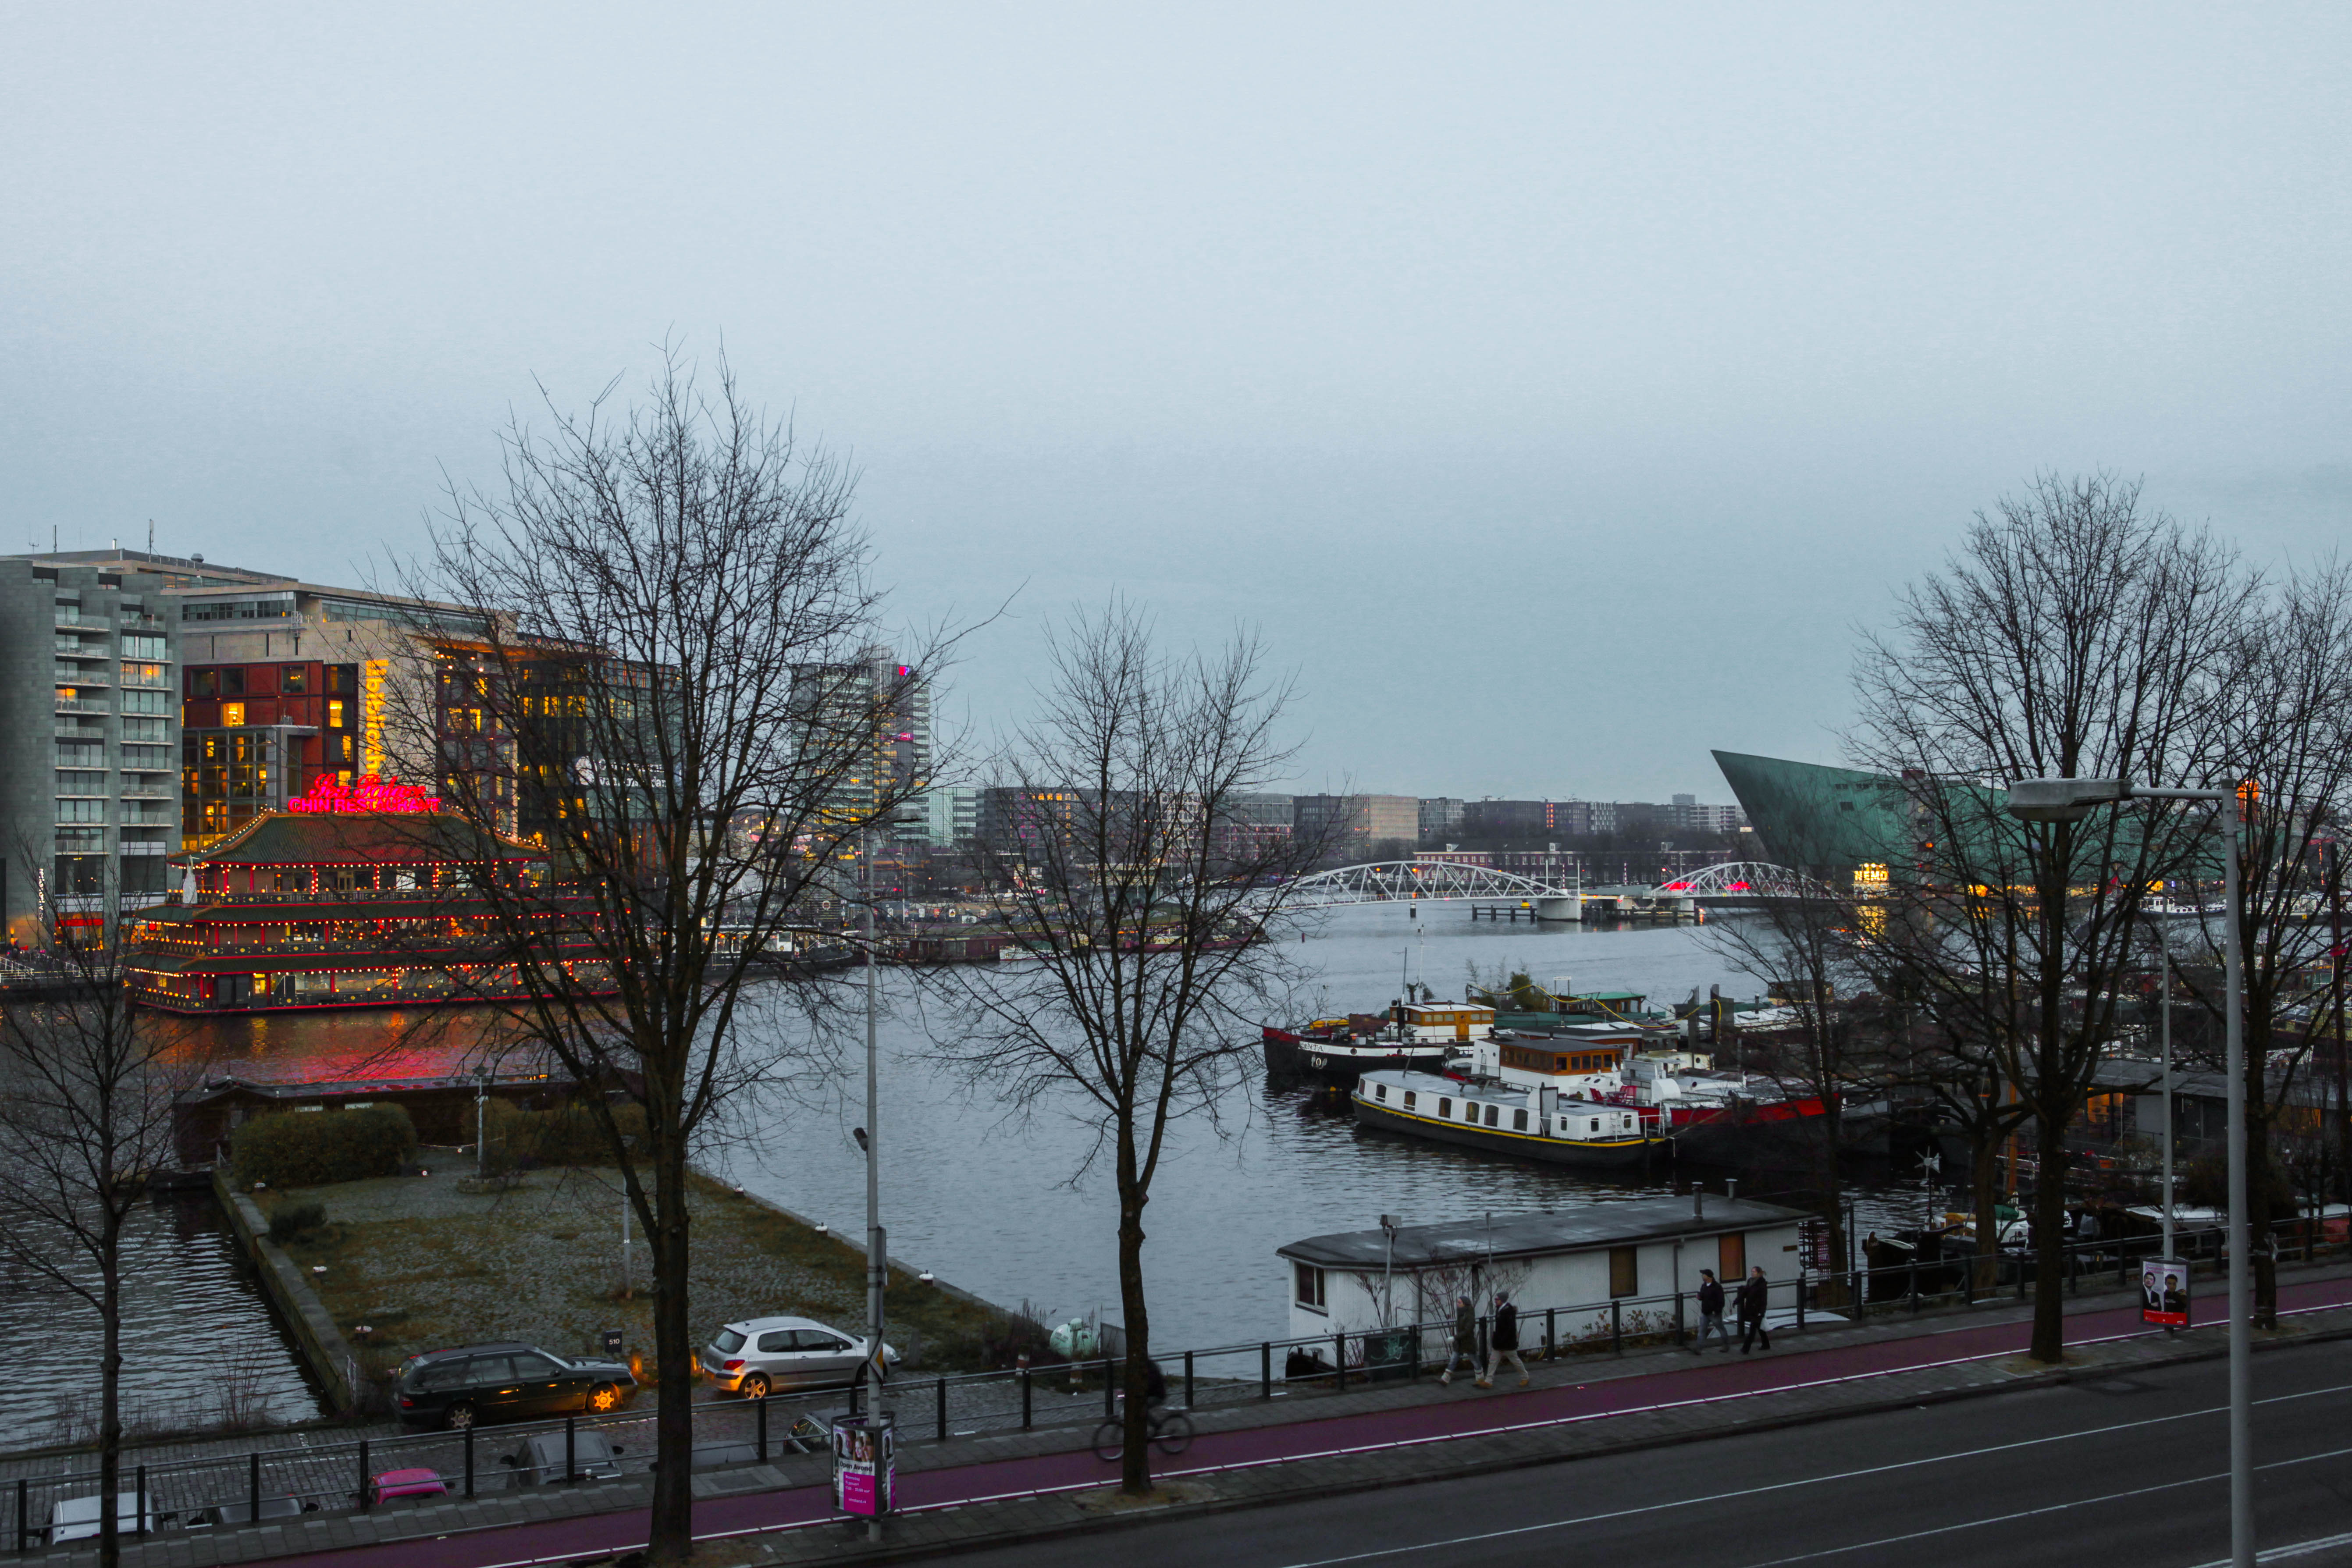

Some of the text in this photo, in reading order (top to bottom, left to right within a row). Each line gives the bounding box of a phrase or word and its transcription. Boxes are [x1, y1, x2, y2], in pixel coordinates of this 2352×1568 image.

[308, 773, 426, 798] Sea Palace
[288, 797, 441, 813] CHIN RESTAURANT
[1854, 871, 1887, 881] NEMO
[840, 1461, 853, 1469] Open
